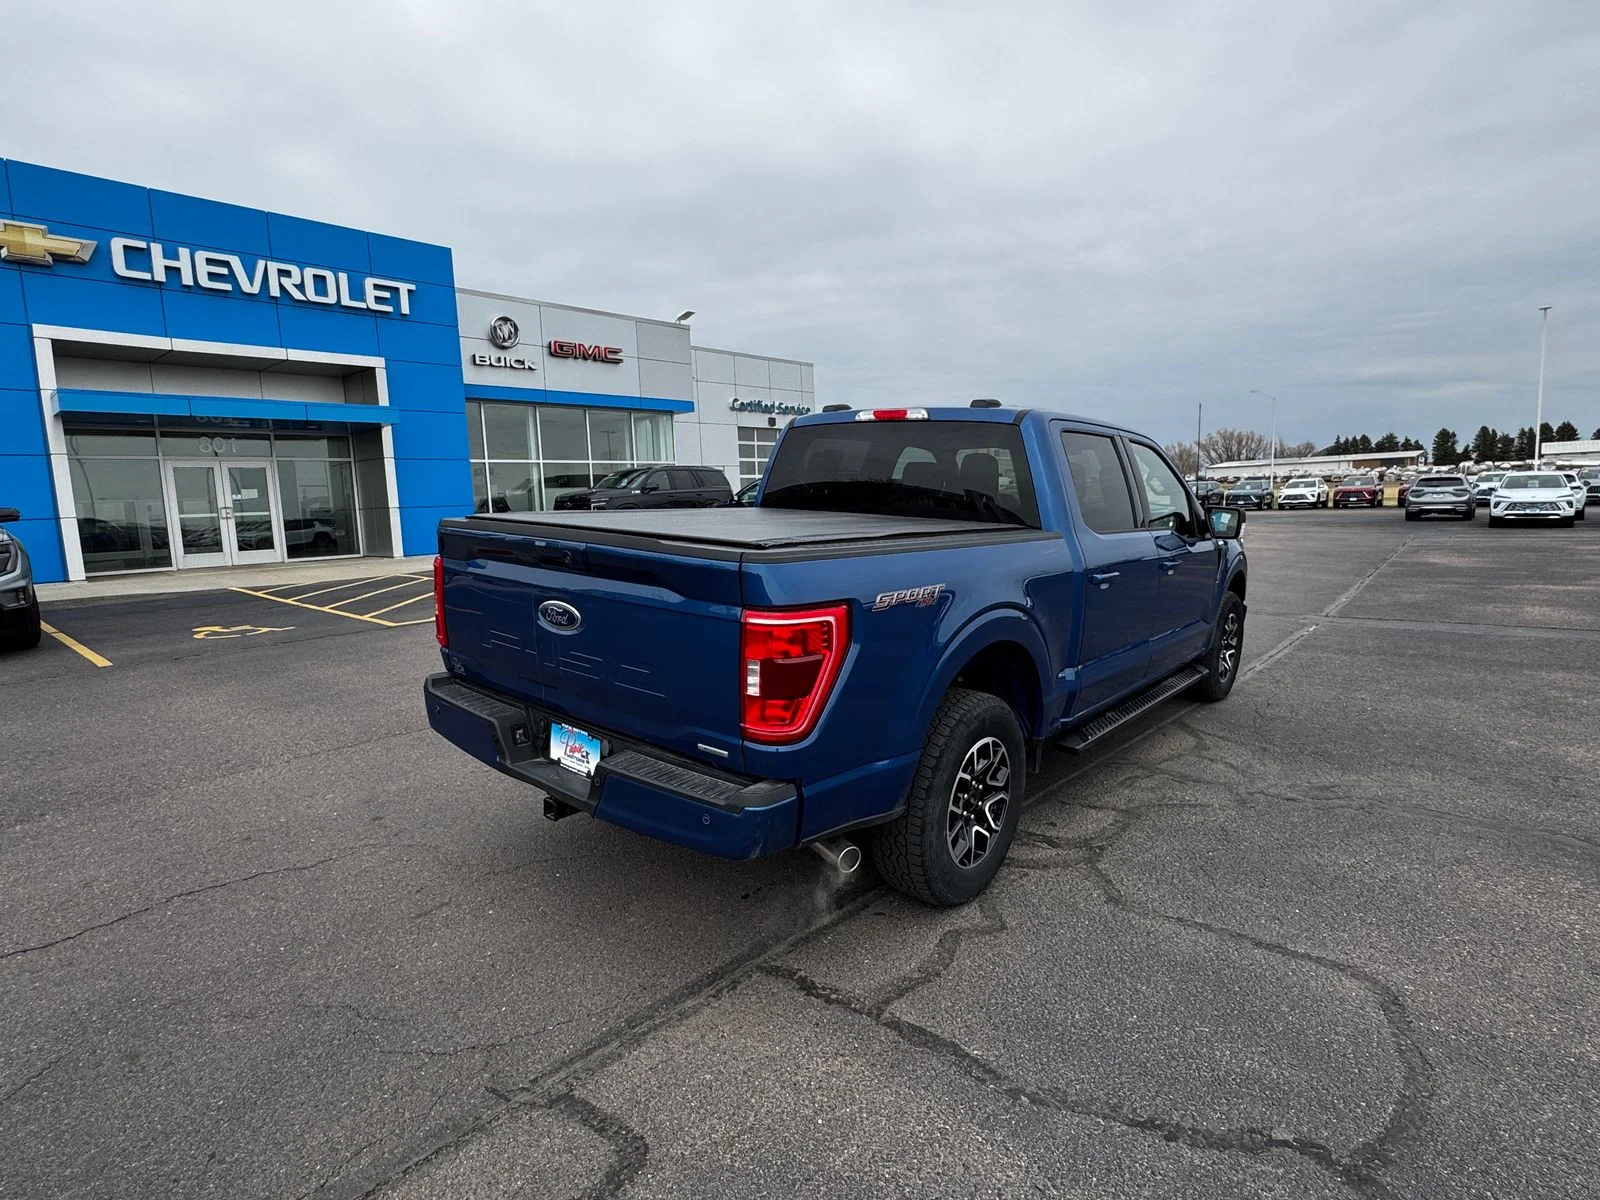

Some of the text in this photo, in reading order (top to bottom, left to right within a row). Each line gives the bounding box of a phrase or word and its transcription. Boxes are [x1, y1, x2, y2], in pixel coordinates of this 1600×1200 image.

[110, 236, 416, 316] CHEVROLET
[549, 339, 624, 364] GMC
[474, 353, 537, 371] BUICK
[730, 397, 811, 417] Certified Service
[199, 436, 237, 454] 801
[871, 582, 946, 612] SPORT
[545, 605, 569, 625] Ford
